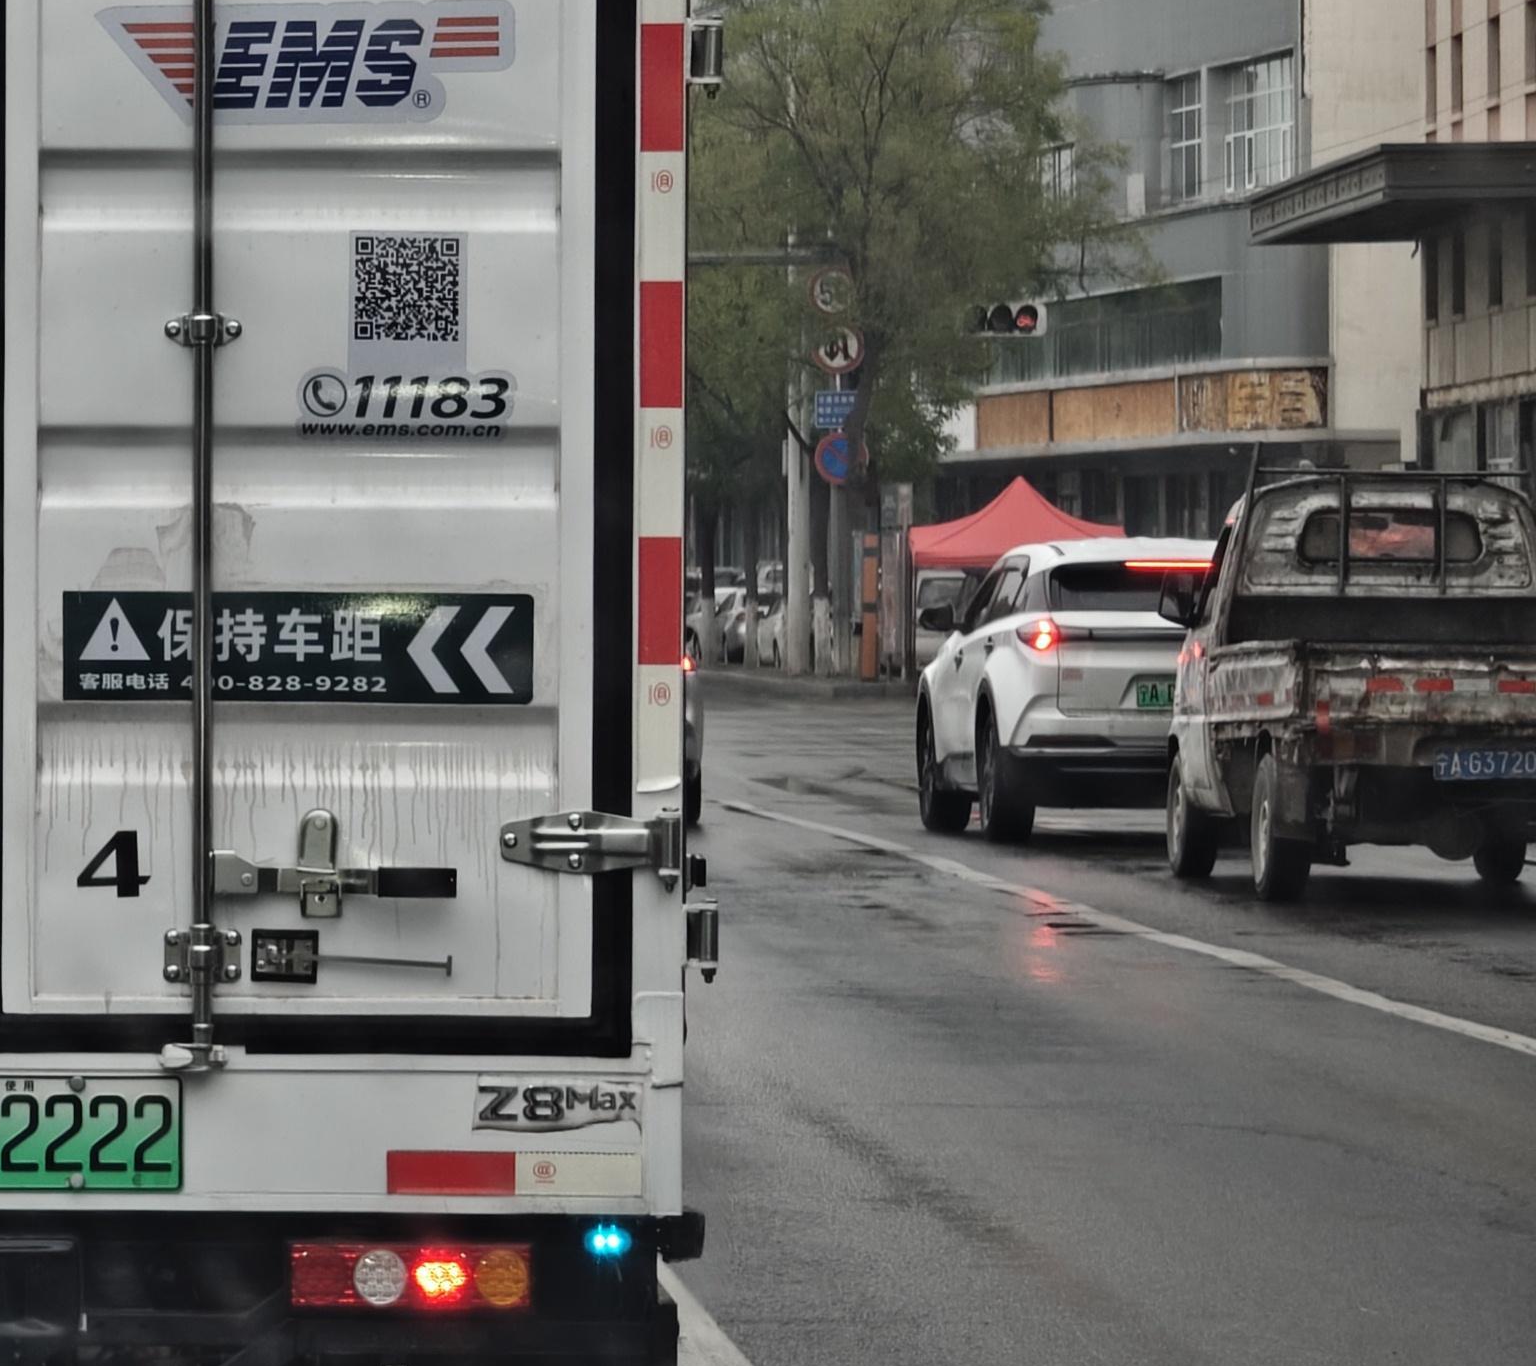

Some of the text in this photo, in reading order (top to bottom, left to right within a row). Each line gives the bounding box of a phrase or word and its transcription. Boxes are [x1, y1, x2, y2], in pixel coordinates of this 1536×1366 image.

[213, 18, 425, 109] EMS
[354, 375, 510, 420] 11183
[301, 421, 502, 439] www.ems.com.cn
[157, 607, 382, 663] 保持车距
[79, 672, 388, 693] 客服电话 40-828-9282
[76, 830, 152, 898] 4
